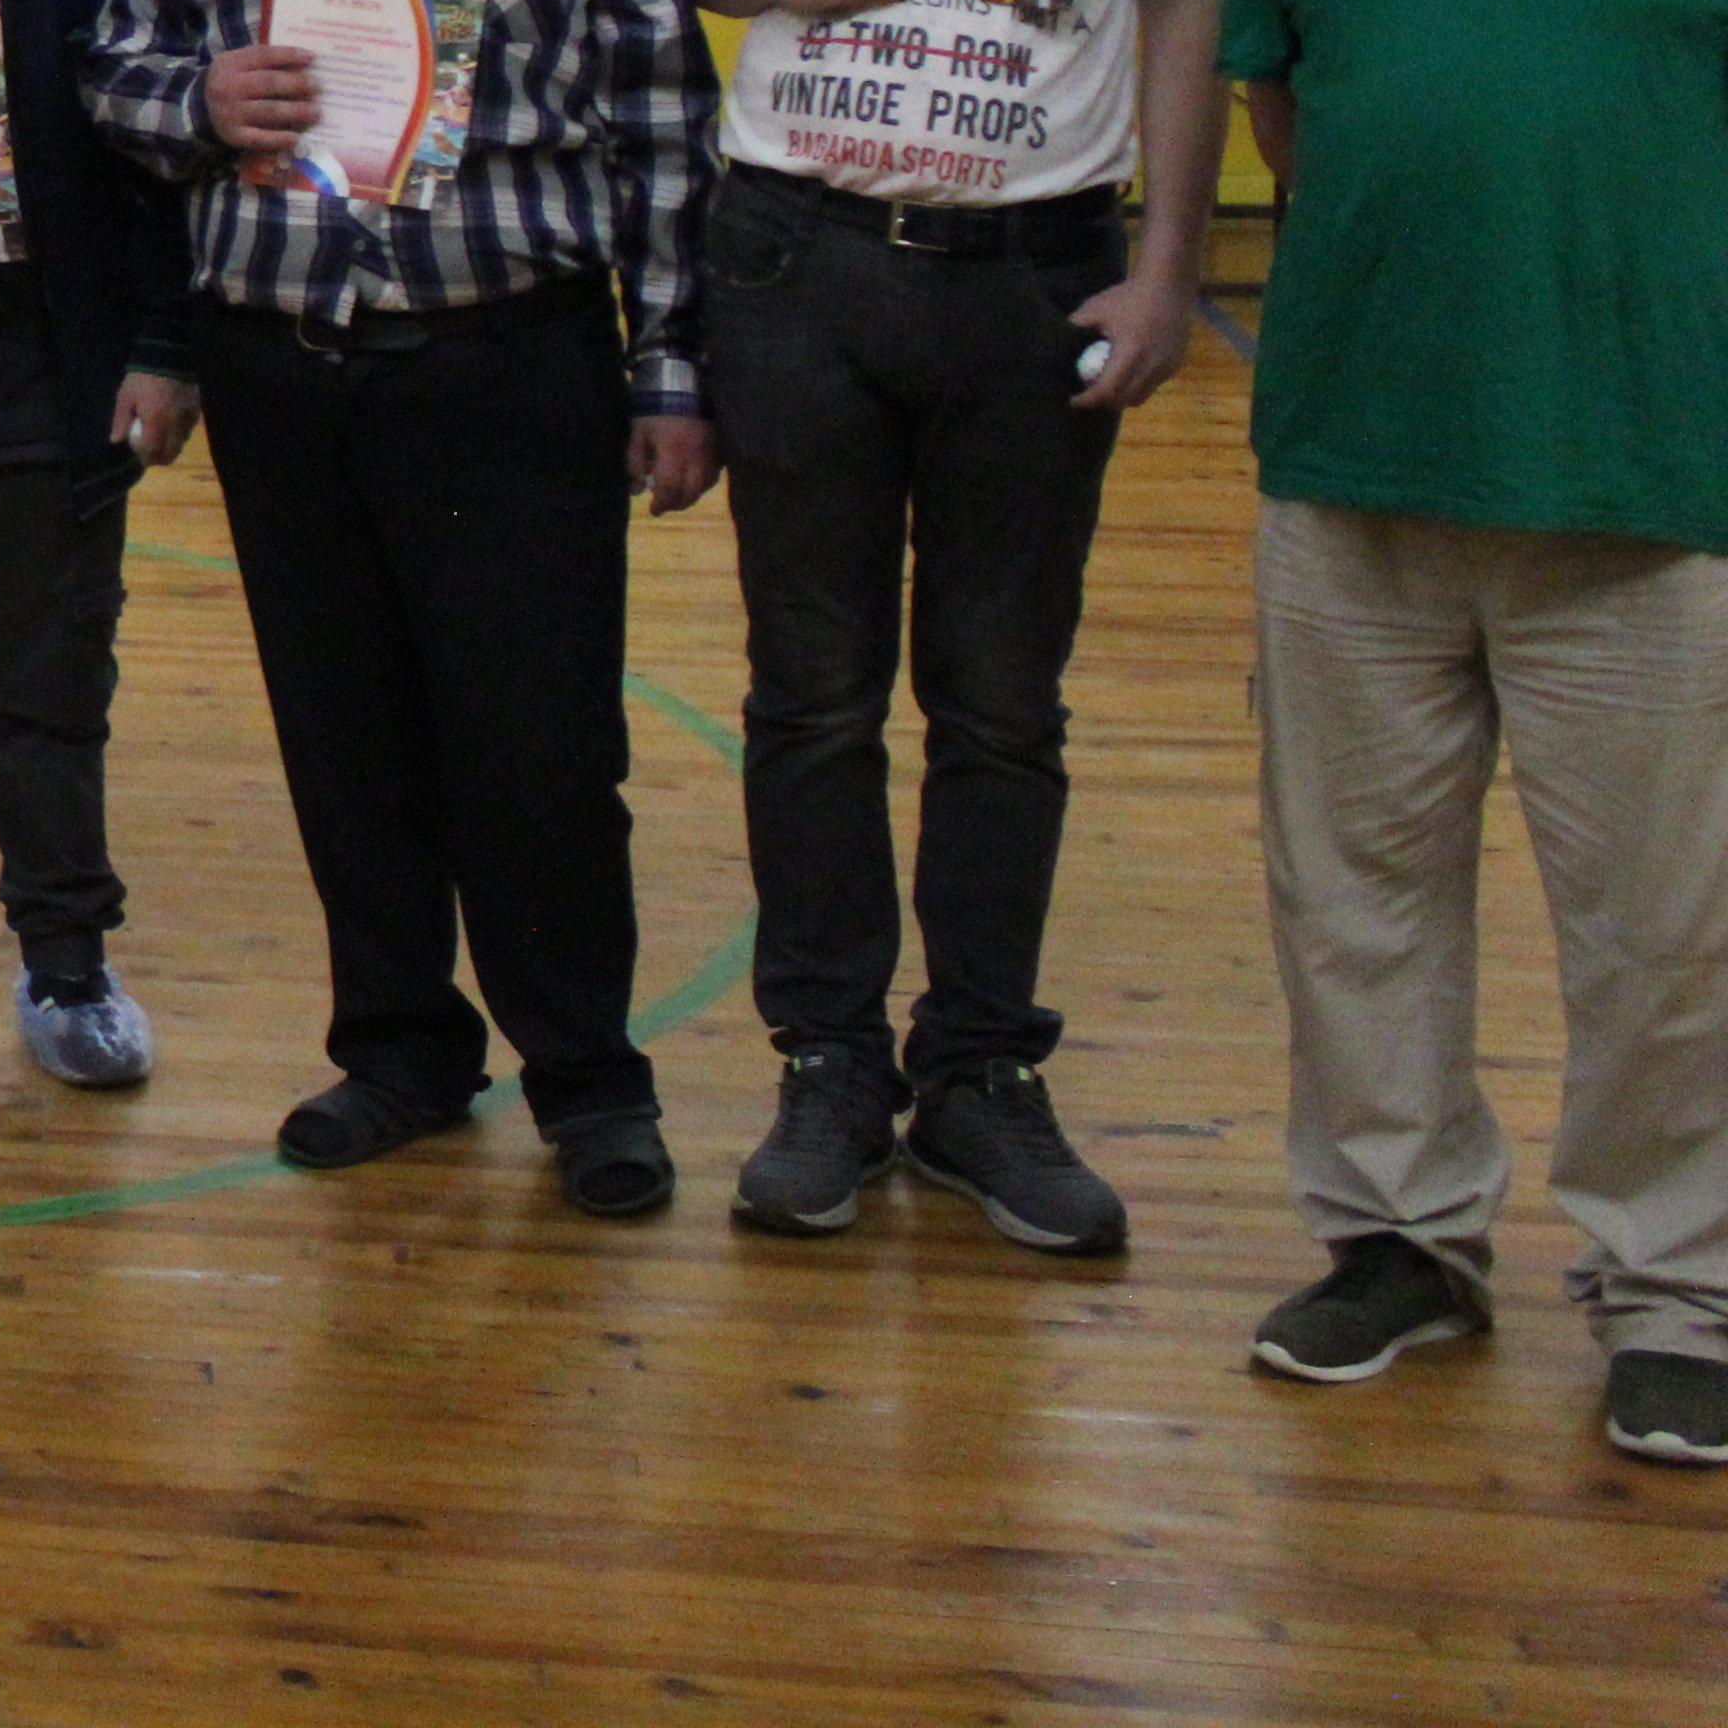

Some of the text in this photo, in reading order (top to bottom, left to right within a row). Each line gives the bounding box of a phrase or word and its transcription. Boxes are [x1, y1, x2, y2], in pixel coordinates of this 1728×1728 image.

[850, 21, 929, 69] TWO
[951, 34, 1032, 88] ROW
[772, 72, 1048, 149] VINTAGE PROPS
[901, 145, 1007, 189] SPORTS
